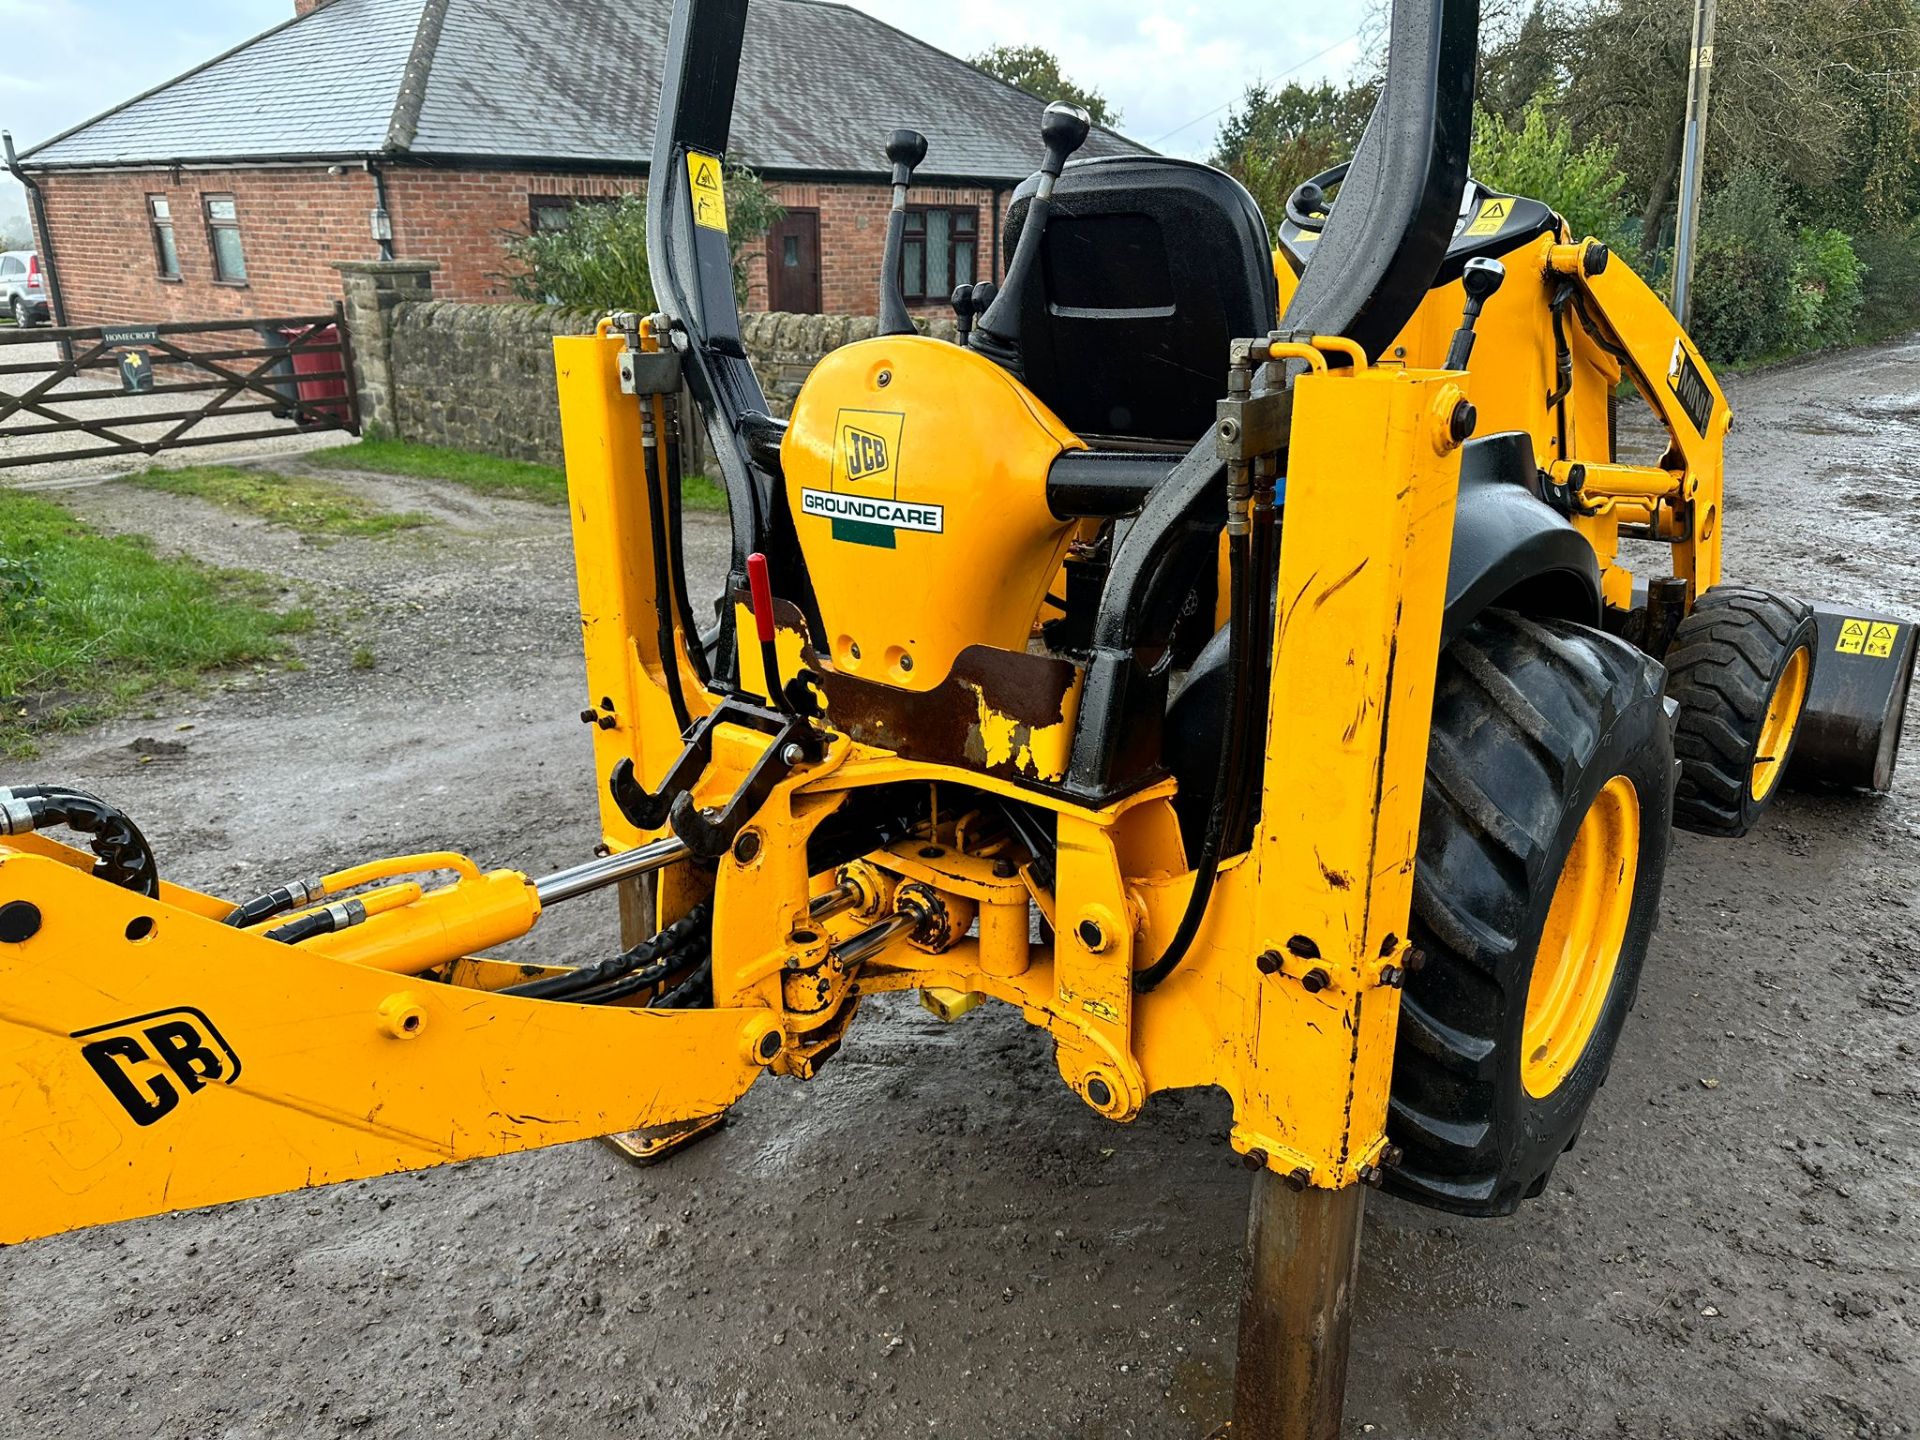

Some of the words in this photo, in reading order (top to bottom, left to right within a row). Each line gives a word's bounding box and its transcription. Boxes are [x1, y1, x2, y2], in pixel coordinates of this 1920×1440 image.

[105, 331, 157, 342] HOMECROFT
[1679, 363, 1707, 422] MINI
[849, 431, 886, 475] JCB
[804, 494, 937, 526] GROUNDCARE
